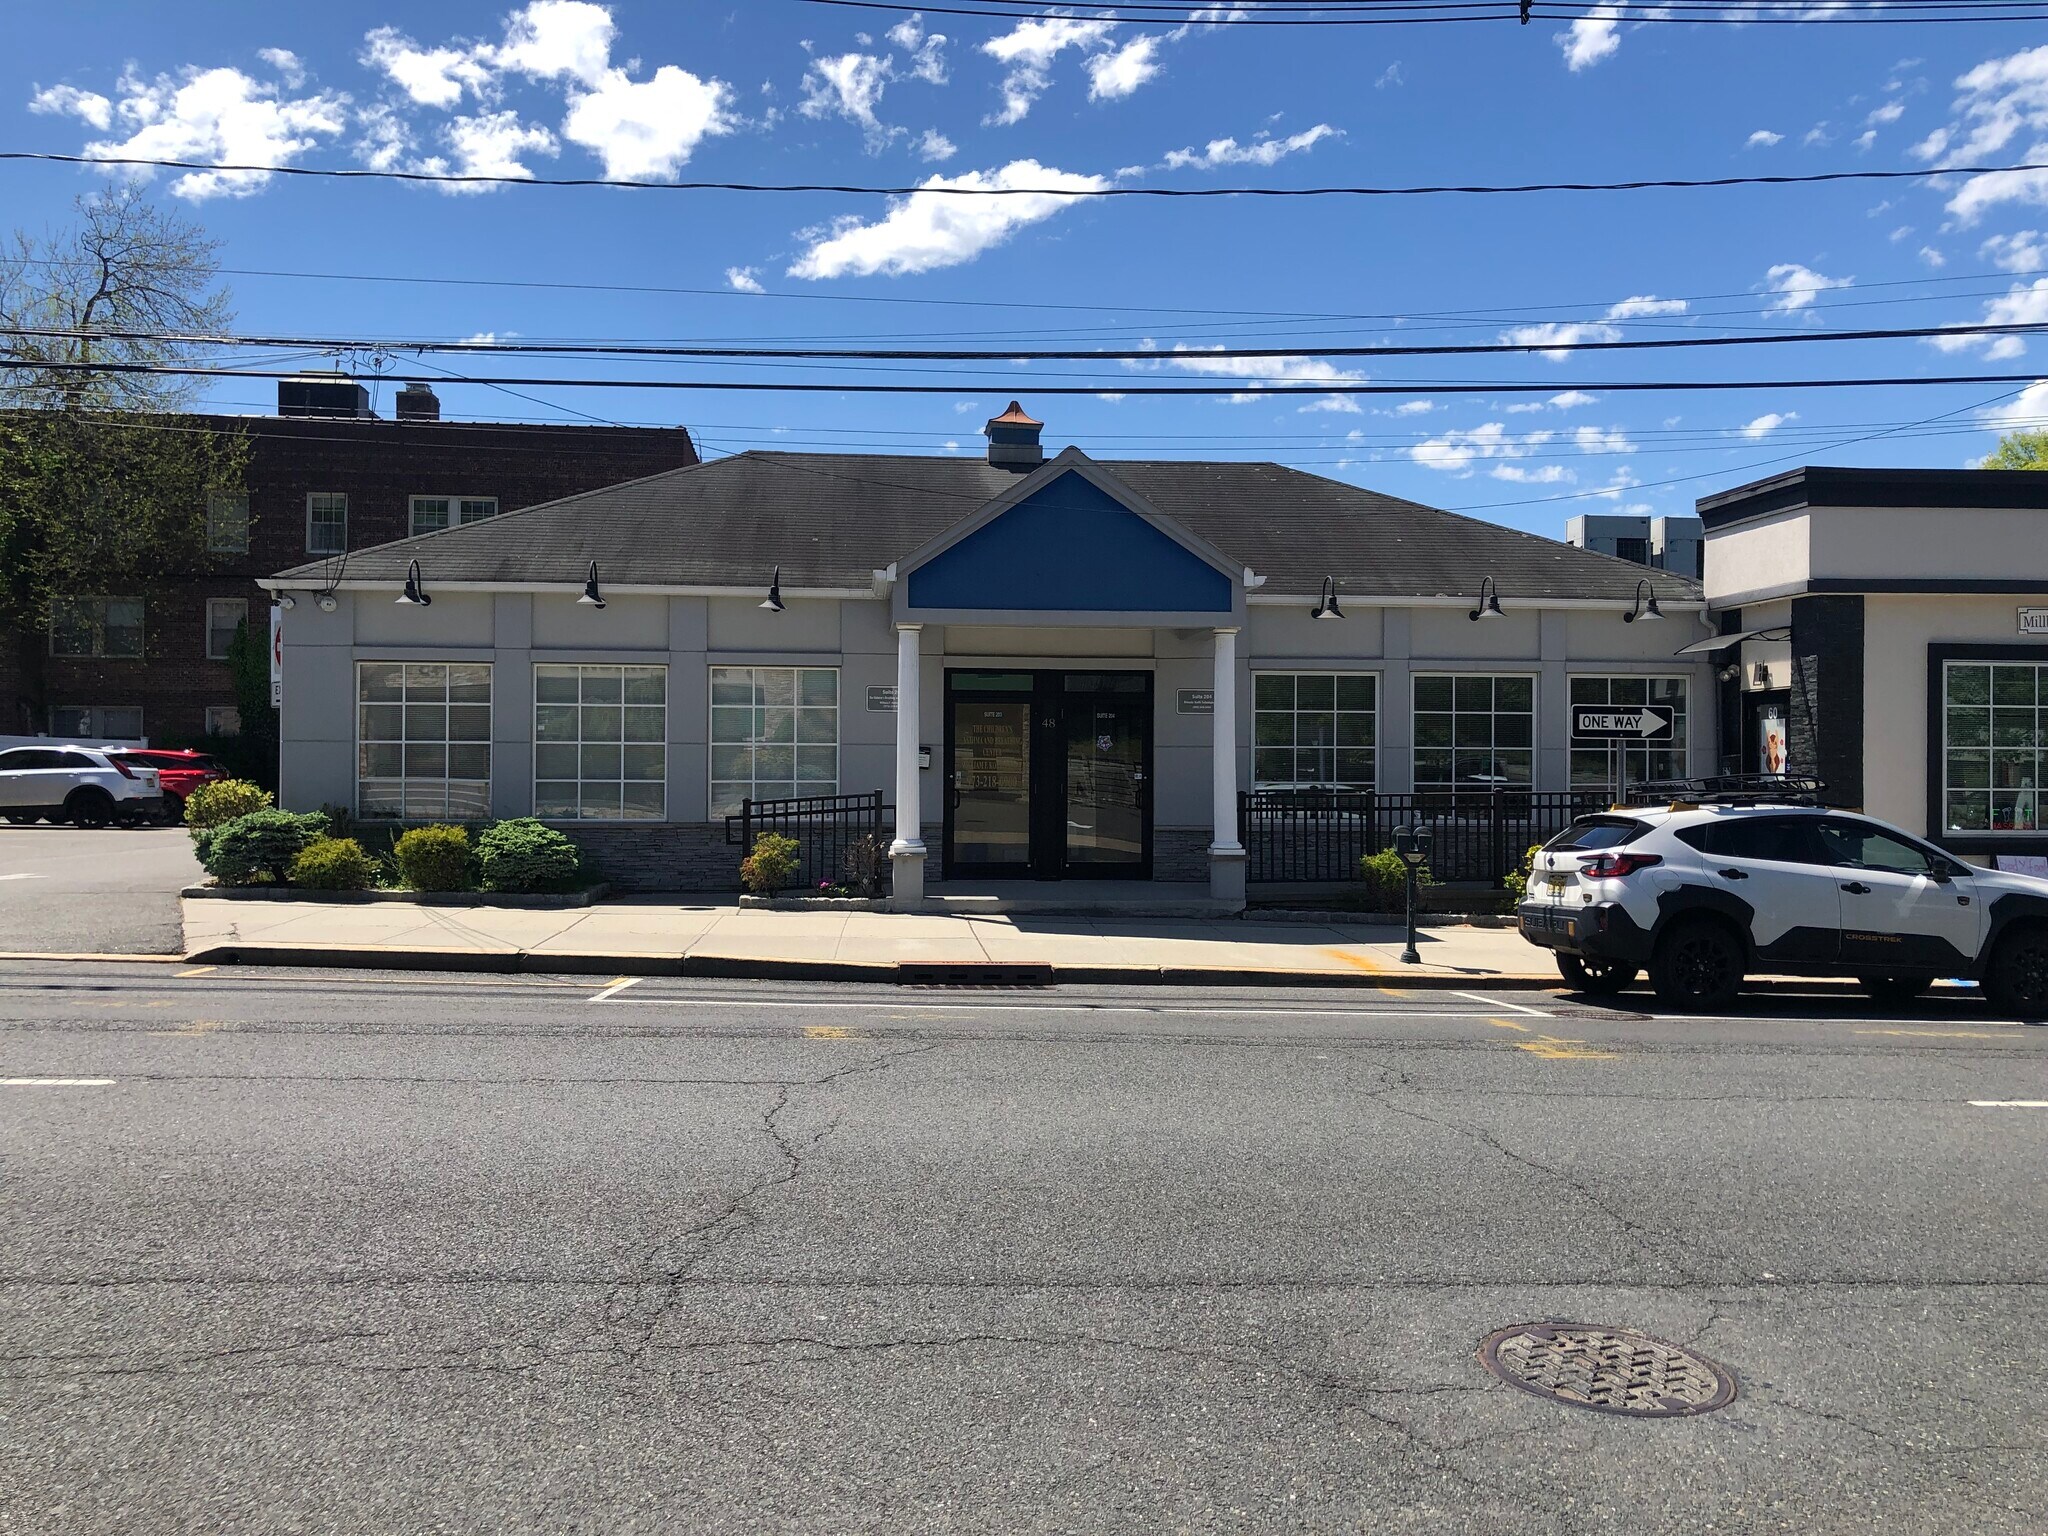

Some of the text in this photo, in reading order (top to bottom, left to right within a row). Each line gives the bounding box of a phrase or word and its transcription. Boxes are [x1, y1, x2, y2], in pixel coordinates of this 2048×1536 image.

[1768, 706, 1778, 719] 60
[1041, 718, 1056, 728] 48
[1582, 715, 1642, 729] ONE WAY
[1524, 916, 1566, 933] SUBARU
[1845, 933, 1904, 943] CROSSTREK
